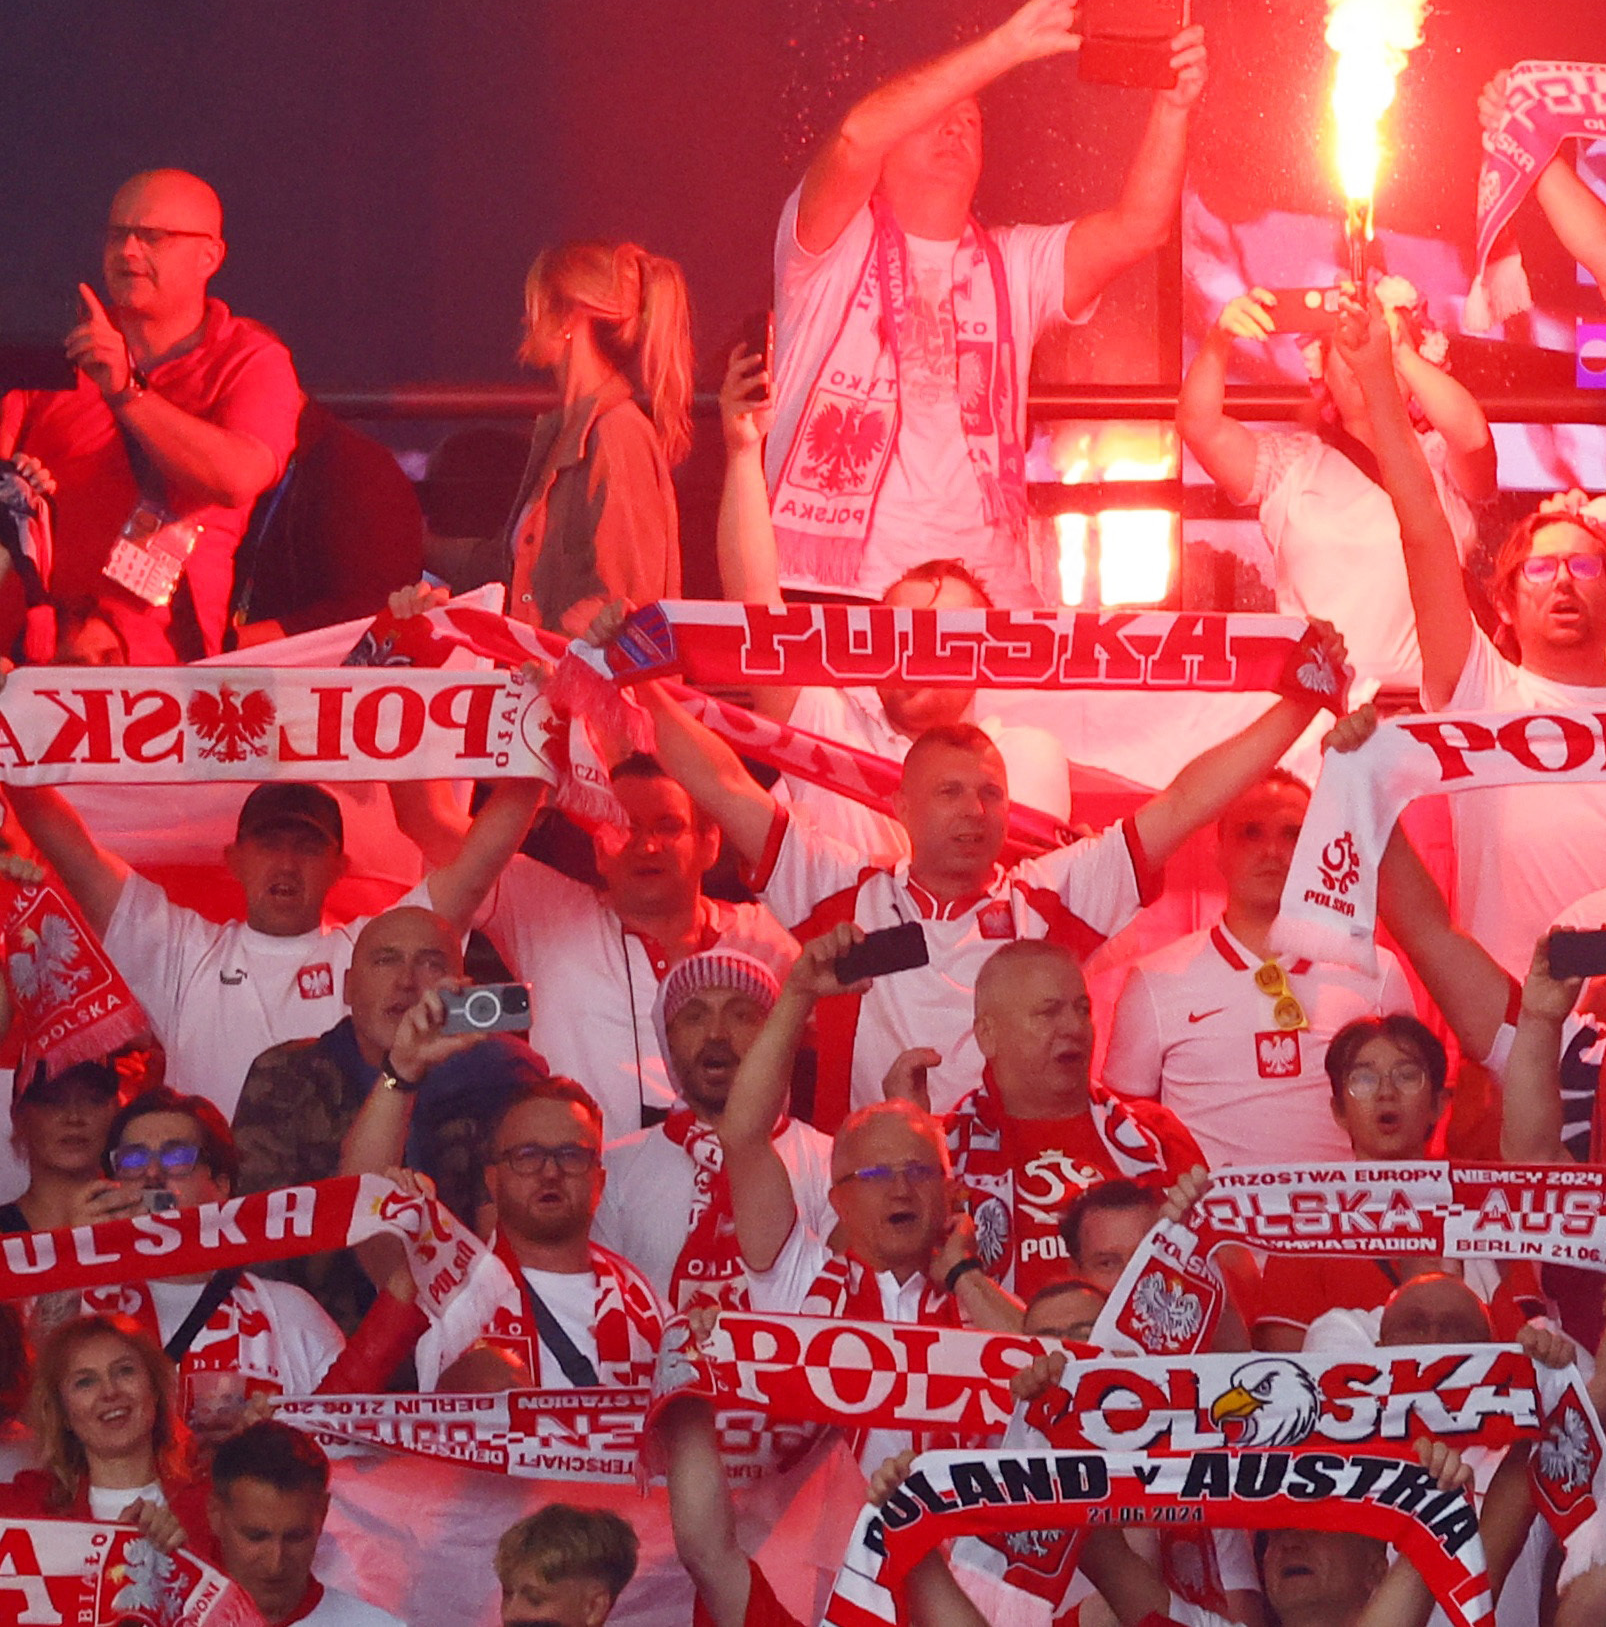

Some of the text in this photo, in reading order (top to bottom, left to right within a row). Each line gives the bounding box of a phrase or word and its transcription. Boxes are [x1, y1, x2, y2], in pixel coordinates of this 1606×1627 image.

[740, 604, 1240, 686] POLSKA
[1302, 886, 1356, 920] POLSKA
[1353, 1168, 1443, 1184] EUROPY
[1452, 1170, 1540, 1186] NIEMCY
[1546, 1172, 1602, 1186] 2024
[1455, 1238, 1544, 1256] BERLIN
[862, 1452, 1112, 1560] POLAND
[1086, 1505, 1204, 1525] 21.06.2024
